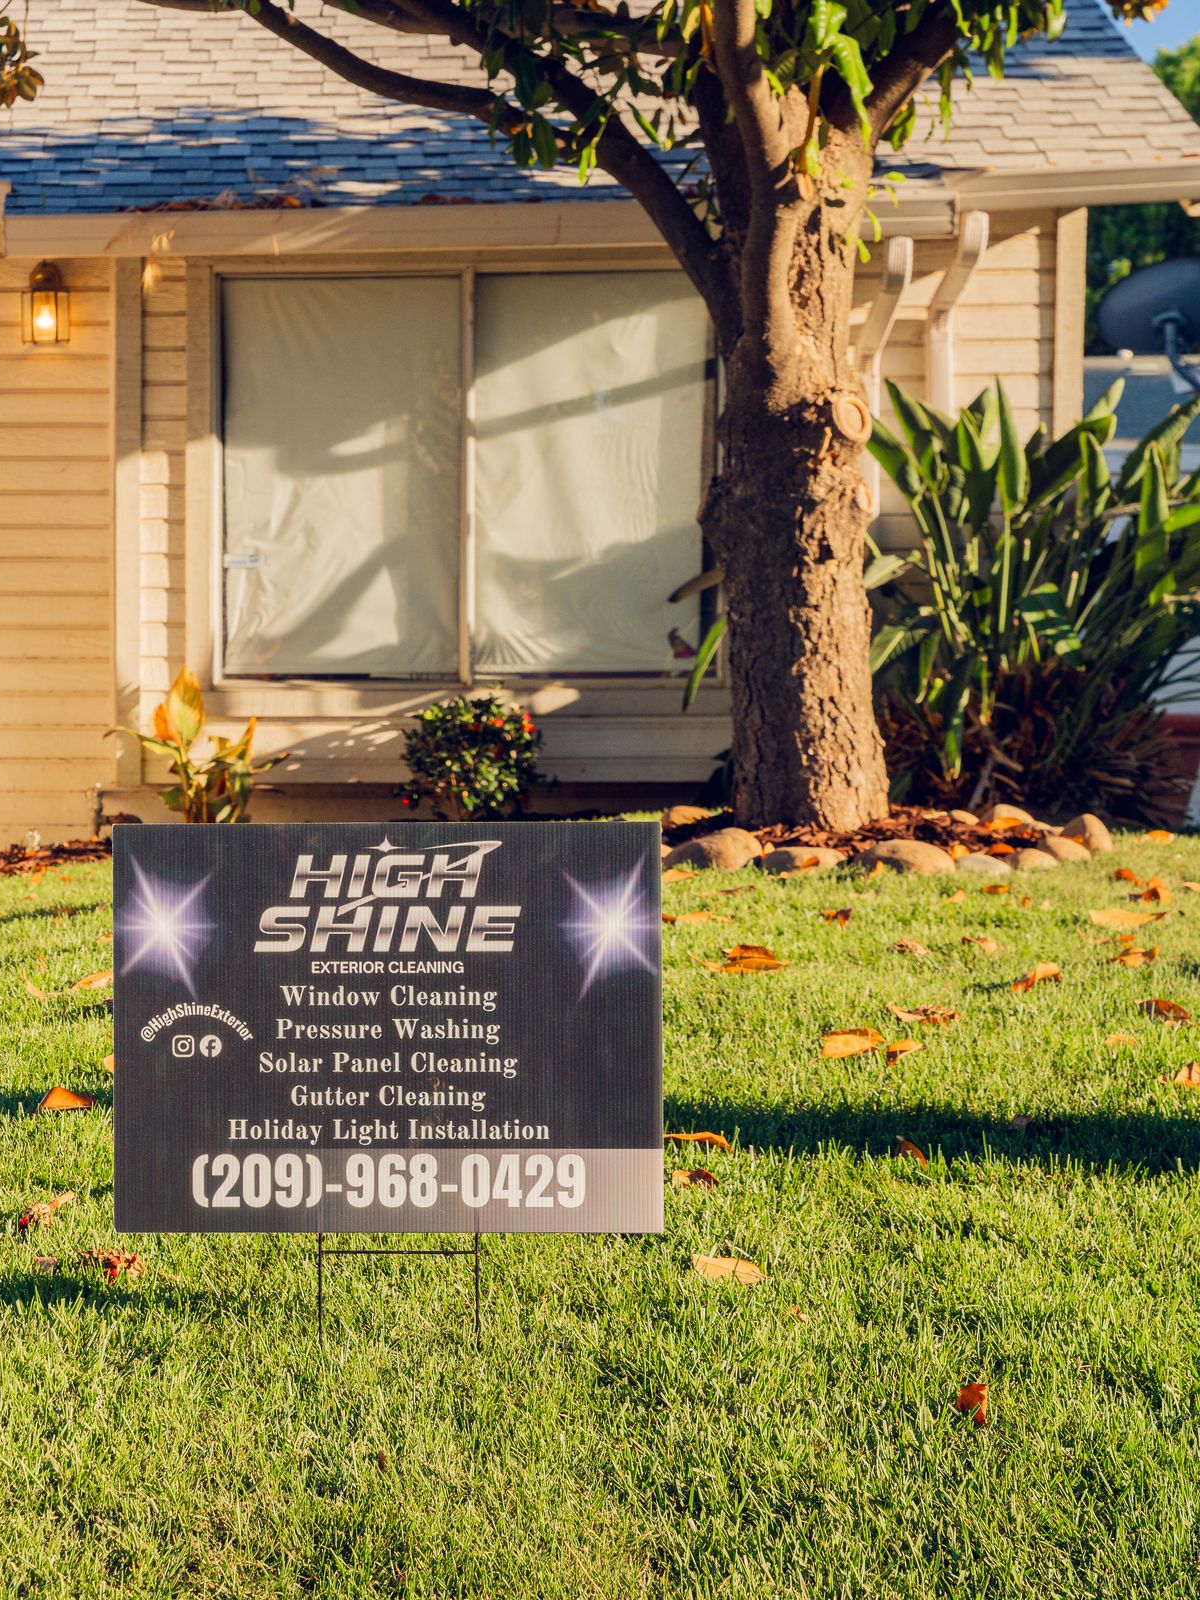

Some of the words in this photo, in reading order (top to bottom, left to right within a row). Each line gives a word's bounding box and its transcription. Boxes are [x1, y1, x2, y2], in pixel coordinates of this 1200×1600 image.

[289, 846, 498, 898] HIGH
[253, 905, 521, 952] SHINE
[311, 961, 384, 974] EXTERIOR
[388, 961, 464, 974] CLEANING
[280, 985, 380, 1006] Window
[390, 985, 497, 1012] Cleaning
[140, 1002, 253, 1042] @HighShineExterior
[276, 1018, 382, 1039] Pressure
[392, 1018, 500, 1045] Washing
[259, 1052, 323, 1073] Solar
[333, 1052, 400, 1073] Panel
[411, 1052, 517, 1079] Cleaning
[291, 1085, 369, 1106] Gutter
[379, 1085, 486, 1112] Cleaning
[228, 1119, 322, 1145] Holiday
[333, 1119, 399, 1145] Light
[408, 1119, 550, 1140] Installation
[192, 1153, 586, 1208] (209)-968-0429
